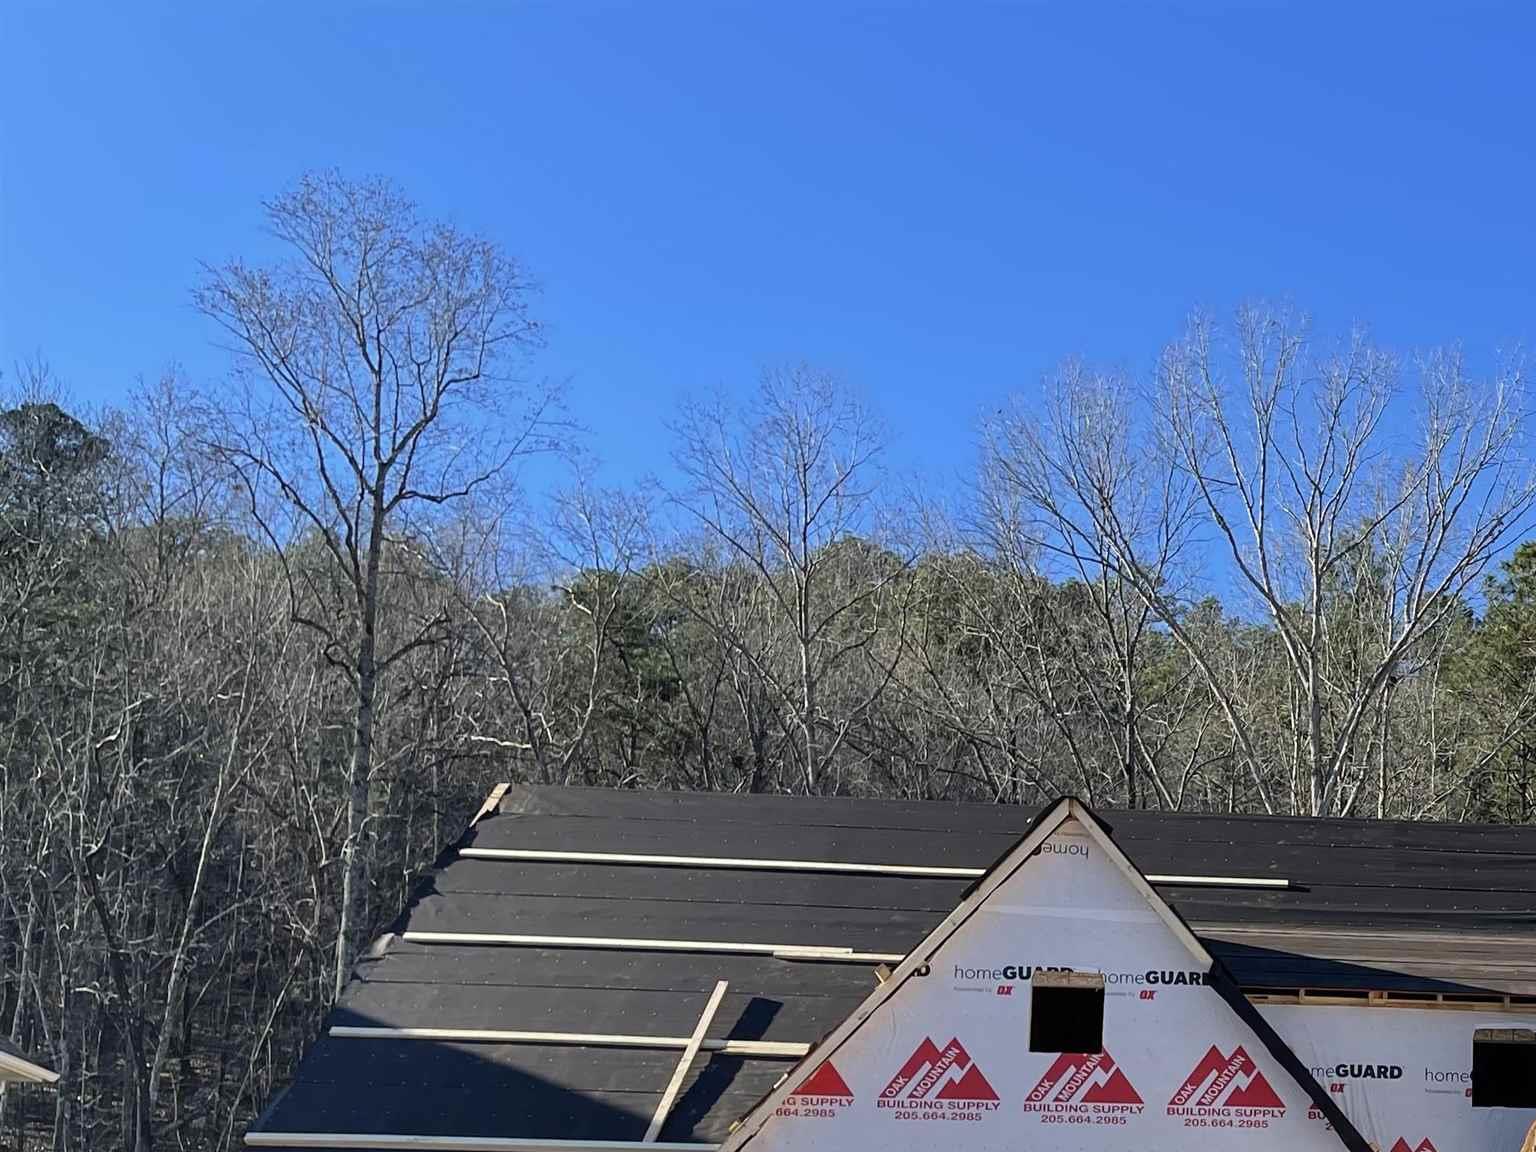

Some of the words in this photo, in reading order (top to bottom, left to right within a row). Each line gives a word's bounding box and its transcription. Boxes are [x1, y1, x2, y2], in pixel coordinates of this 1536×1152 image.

[1139, 990, 1156, 1000] OX
[913, 1046, 960, 1099] MOUNTAIN
[1059, 1052, 1103, 1102] MOUNTAIN
[1201, 1055, 1246, 1106] MOUNTAIN
[885, 1075, 908, 1098] OAK
[1031, 1080, 1053, 1101] OAK
[1330, 1083, 1344, 1093] OX
[1174, 1083, 1196, 1105] OAK
[800, 1097, 854, 1108] SUPPLY
[877, 1100, 942, 1111] BUILDING
[946, 1101, 1001, 1111] SUPPLY
[1024, 1103, 1088, 1114] BUILDING
[1092, 1105, 1145, 1115] SUPPLY
[1167, 1107, 1230, 1117] BUILDING
[1234, 1108, 1286, 1118] SUPPLY
[894, 1111, 982, 1122] 205.664.2985
[1041, 1114, 1126, 1125] 205.664.2985
[1184, 1118, 1269, 1128] 205.664.2985
